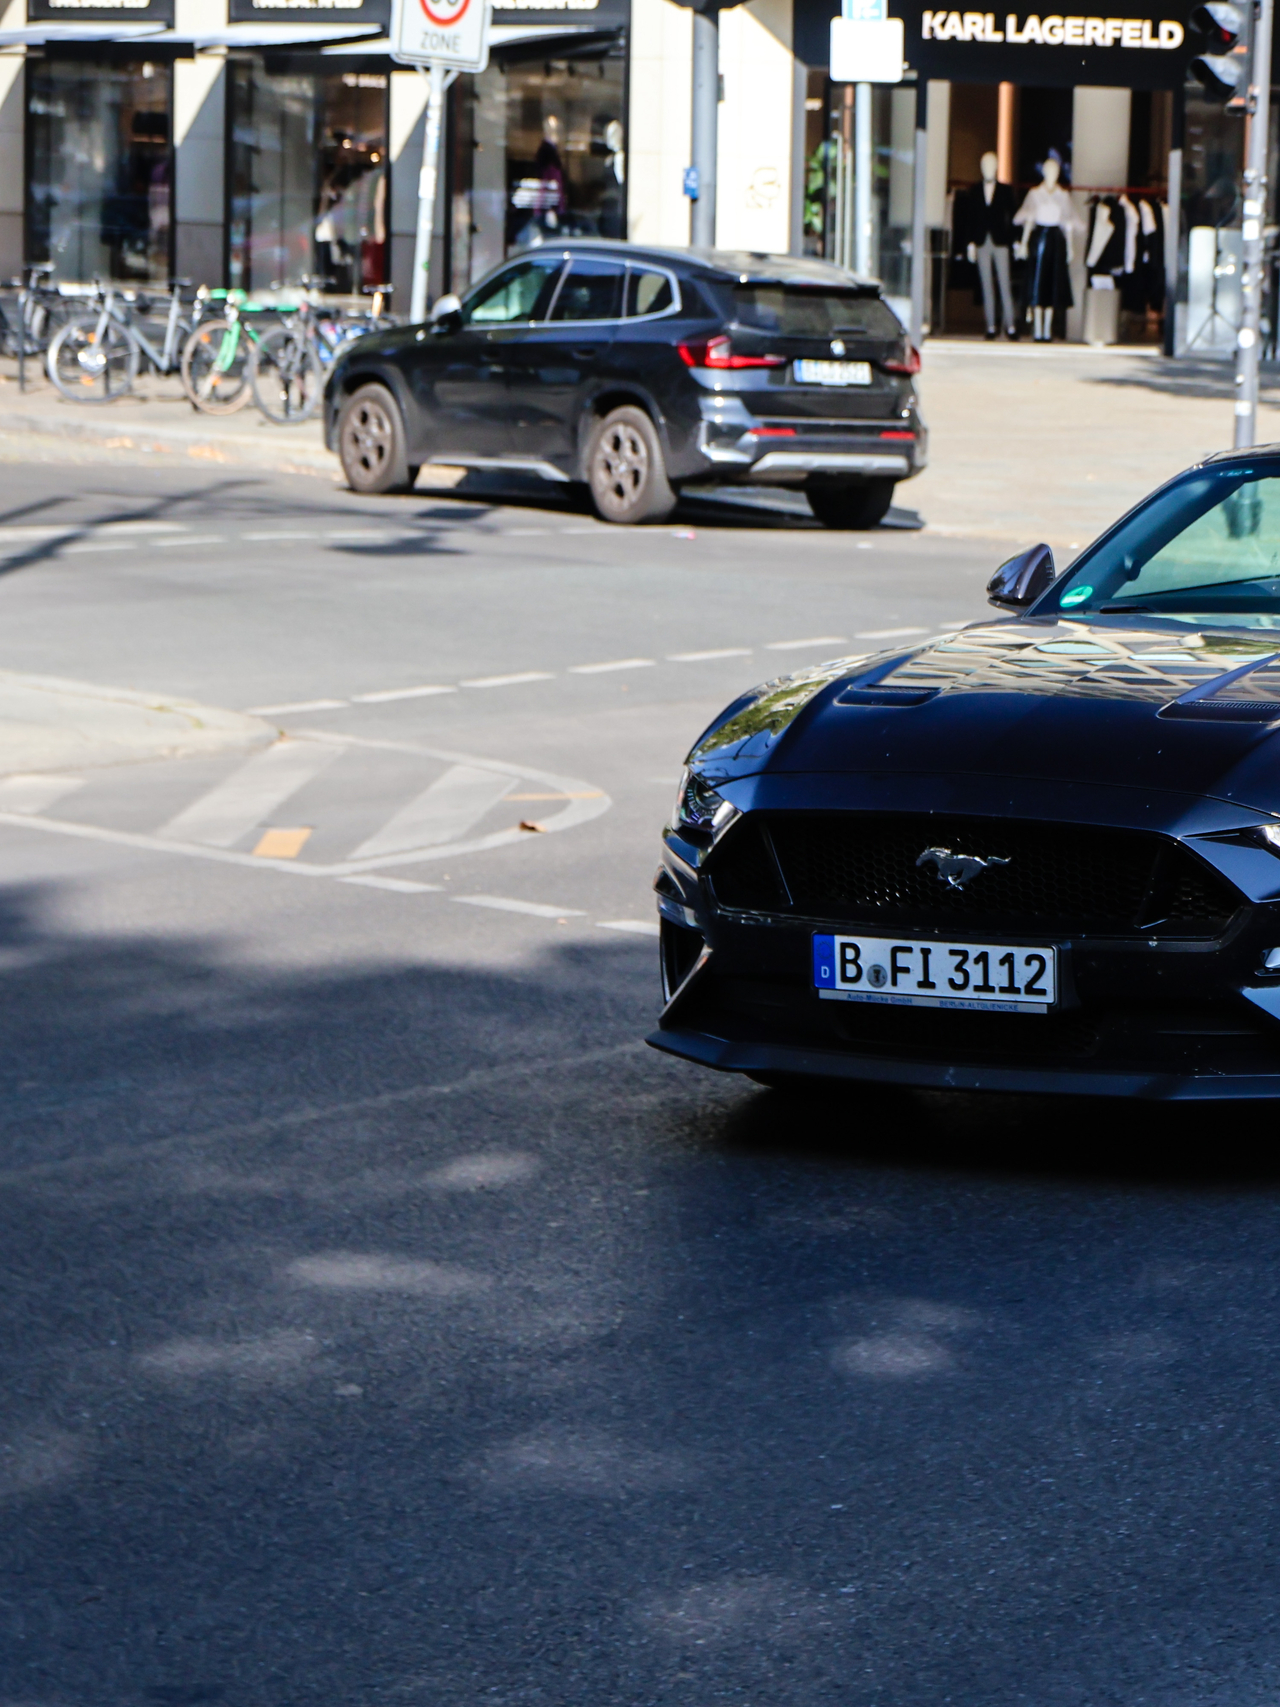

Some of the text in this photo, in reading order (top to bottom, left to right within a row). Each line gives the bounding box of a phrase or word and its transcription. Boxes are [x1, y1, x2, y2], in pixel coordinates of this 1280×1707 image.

[922, 10, 1185, 49] KARL LAGERFELD
[420, 30, 462, 54] ZONE
[821, 966, 830, 978] D
[840, 942, 1047, 996] B FI 3112
[890, 996, 912, 1004] GmbH
[939, 1000, 1019, 1011] BERLIN-ALTGLIENICKE
